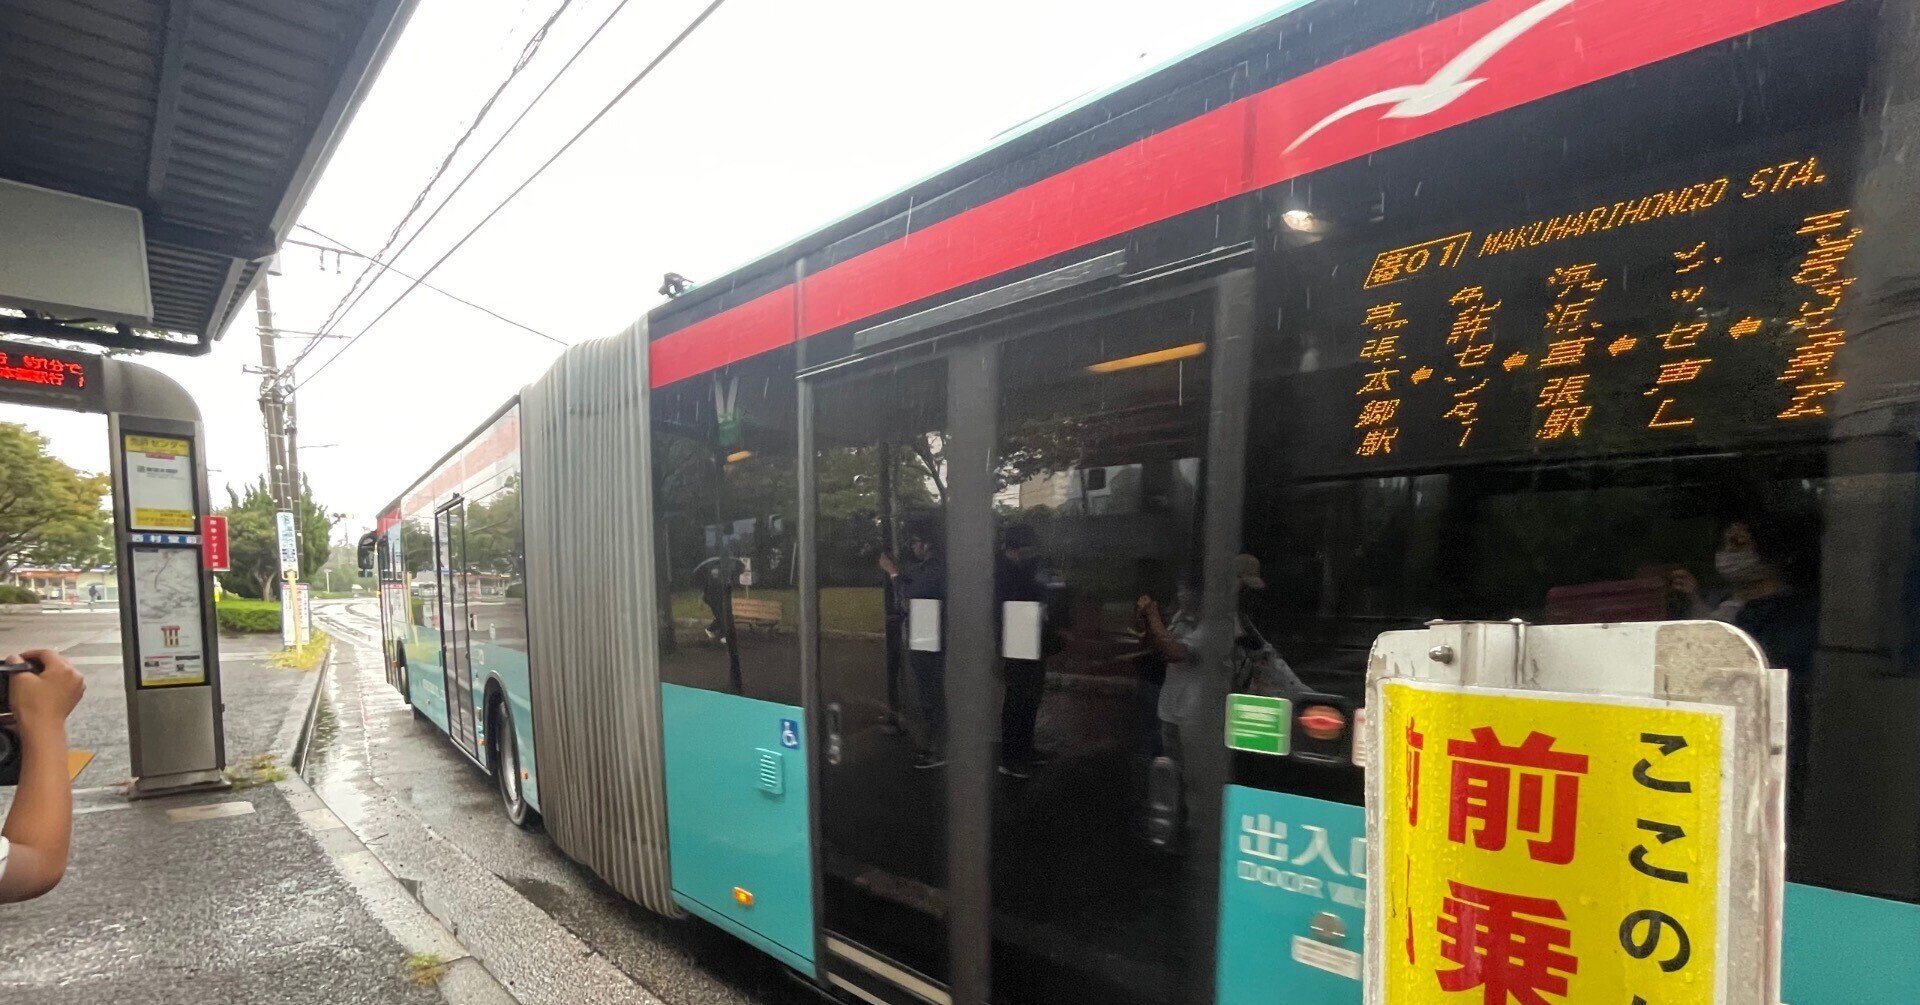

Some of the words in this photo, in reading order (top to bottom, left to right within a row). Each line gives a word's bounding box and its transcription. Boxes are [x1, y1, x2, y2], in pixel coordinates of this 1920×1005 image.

[1479, 178, 1729, 258] MAKUHARIHONGO
[1742, 156, 1826, 198] STA.
[1619, 732, 1692, 1005] ここの
